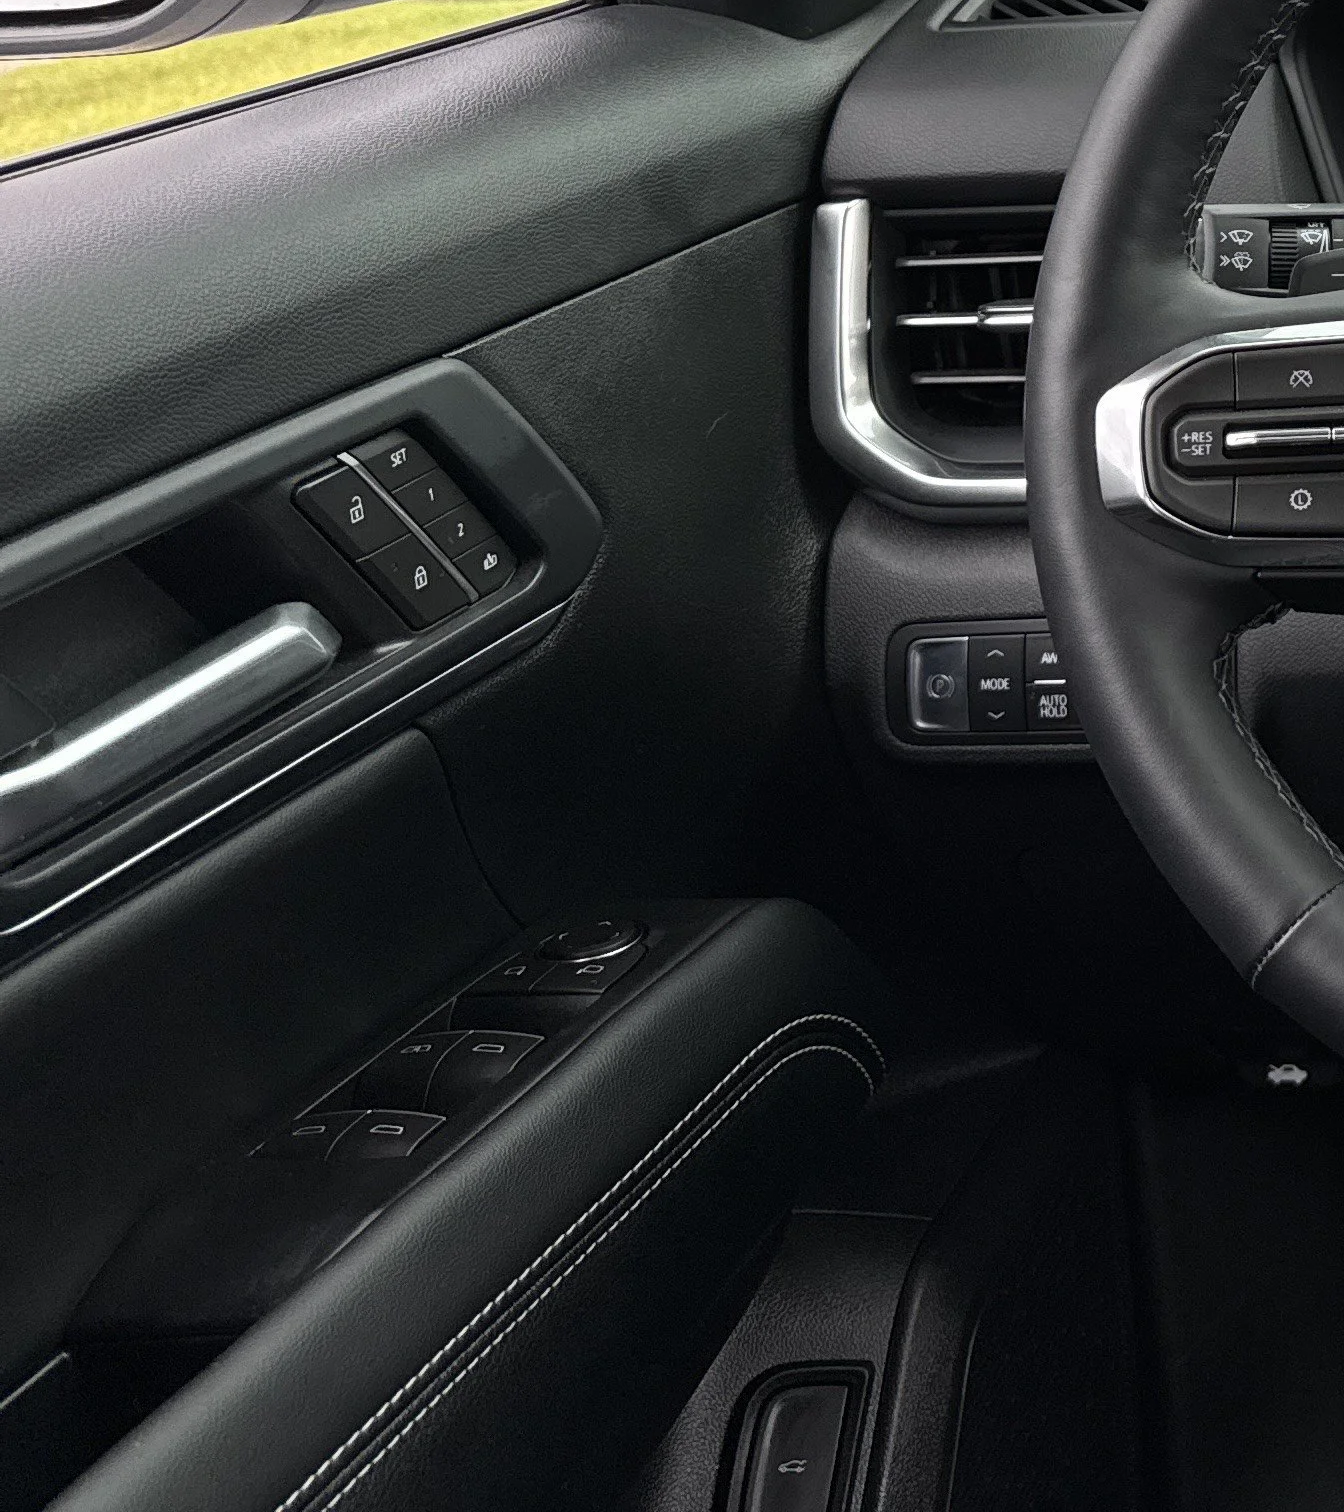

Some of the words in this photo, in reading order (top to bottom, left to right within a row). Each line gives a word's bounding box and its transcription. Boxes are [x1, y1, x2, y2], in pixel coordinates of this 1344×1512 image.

[391, 448, 406, 467] SET
[980, 677, 1010, 691] MODE
[1040, 694, 1068, 707] AUTO
[1040, 705, 1068, 718] HOLD
